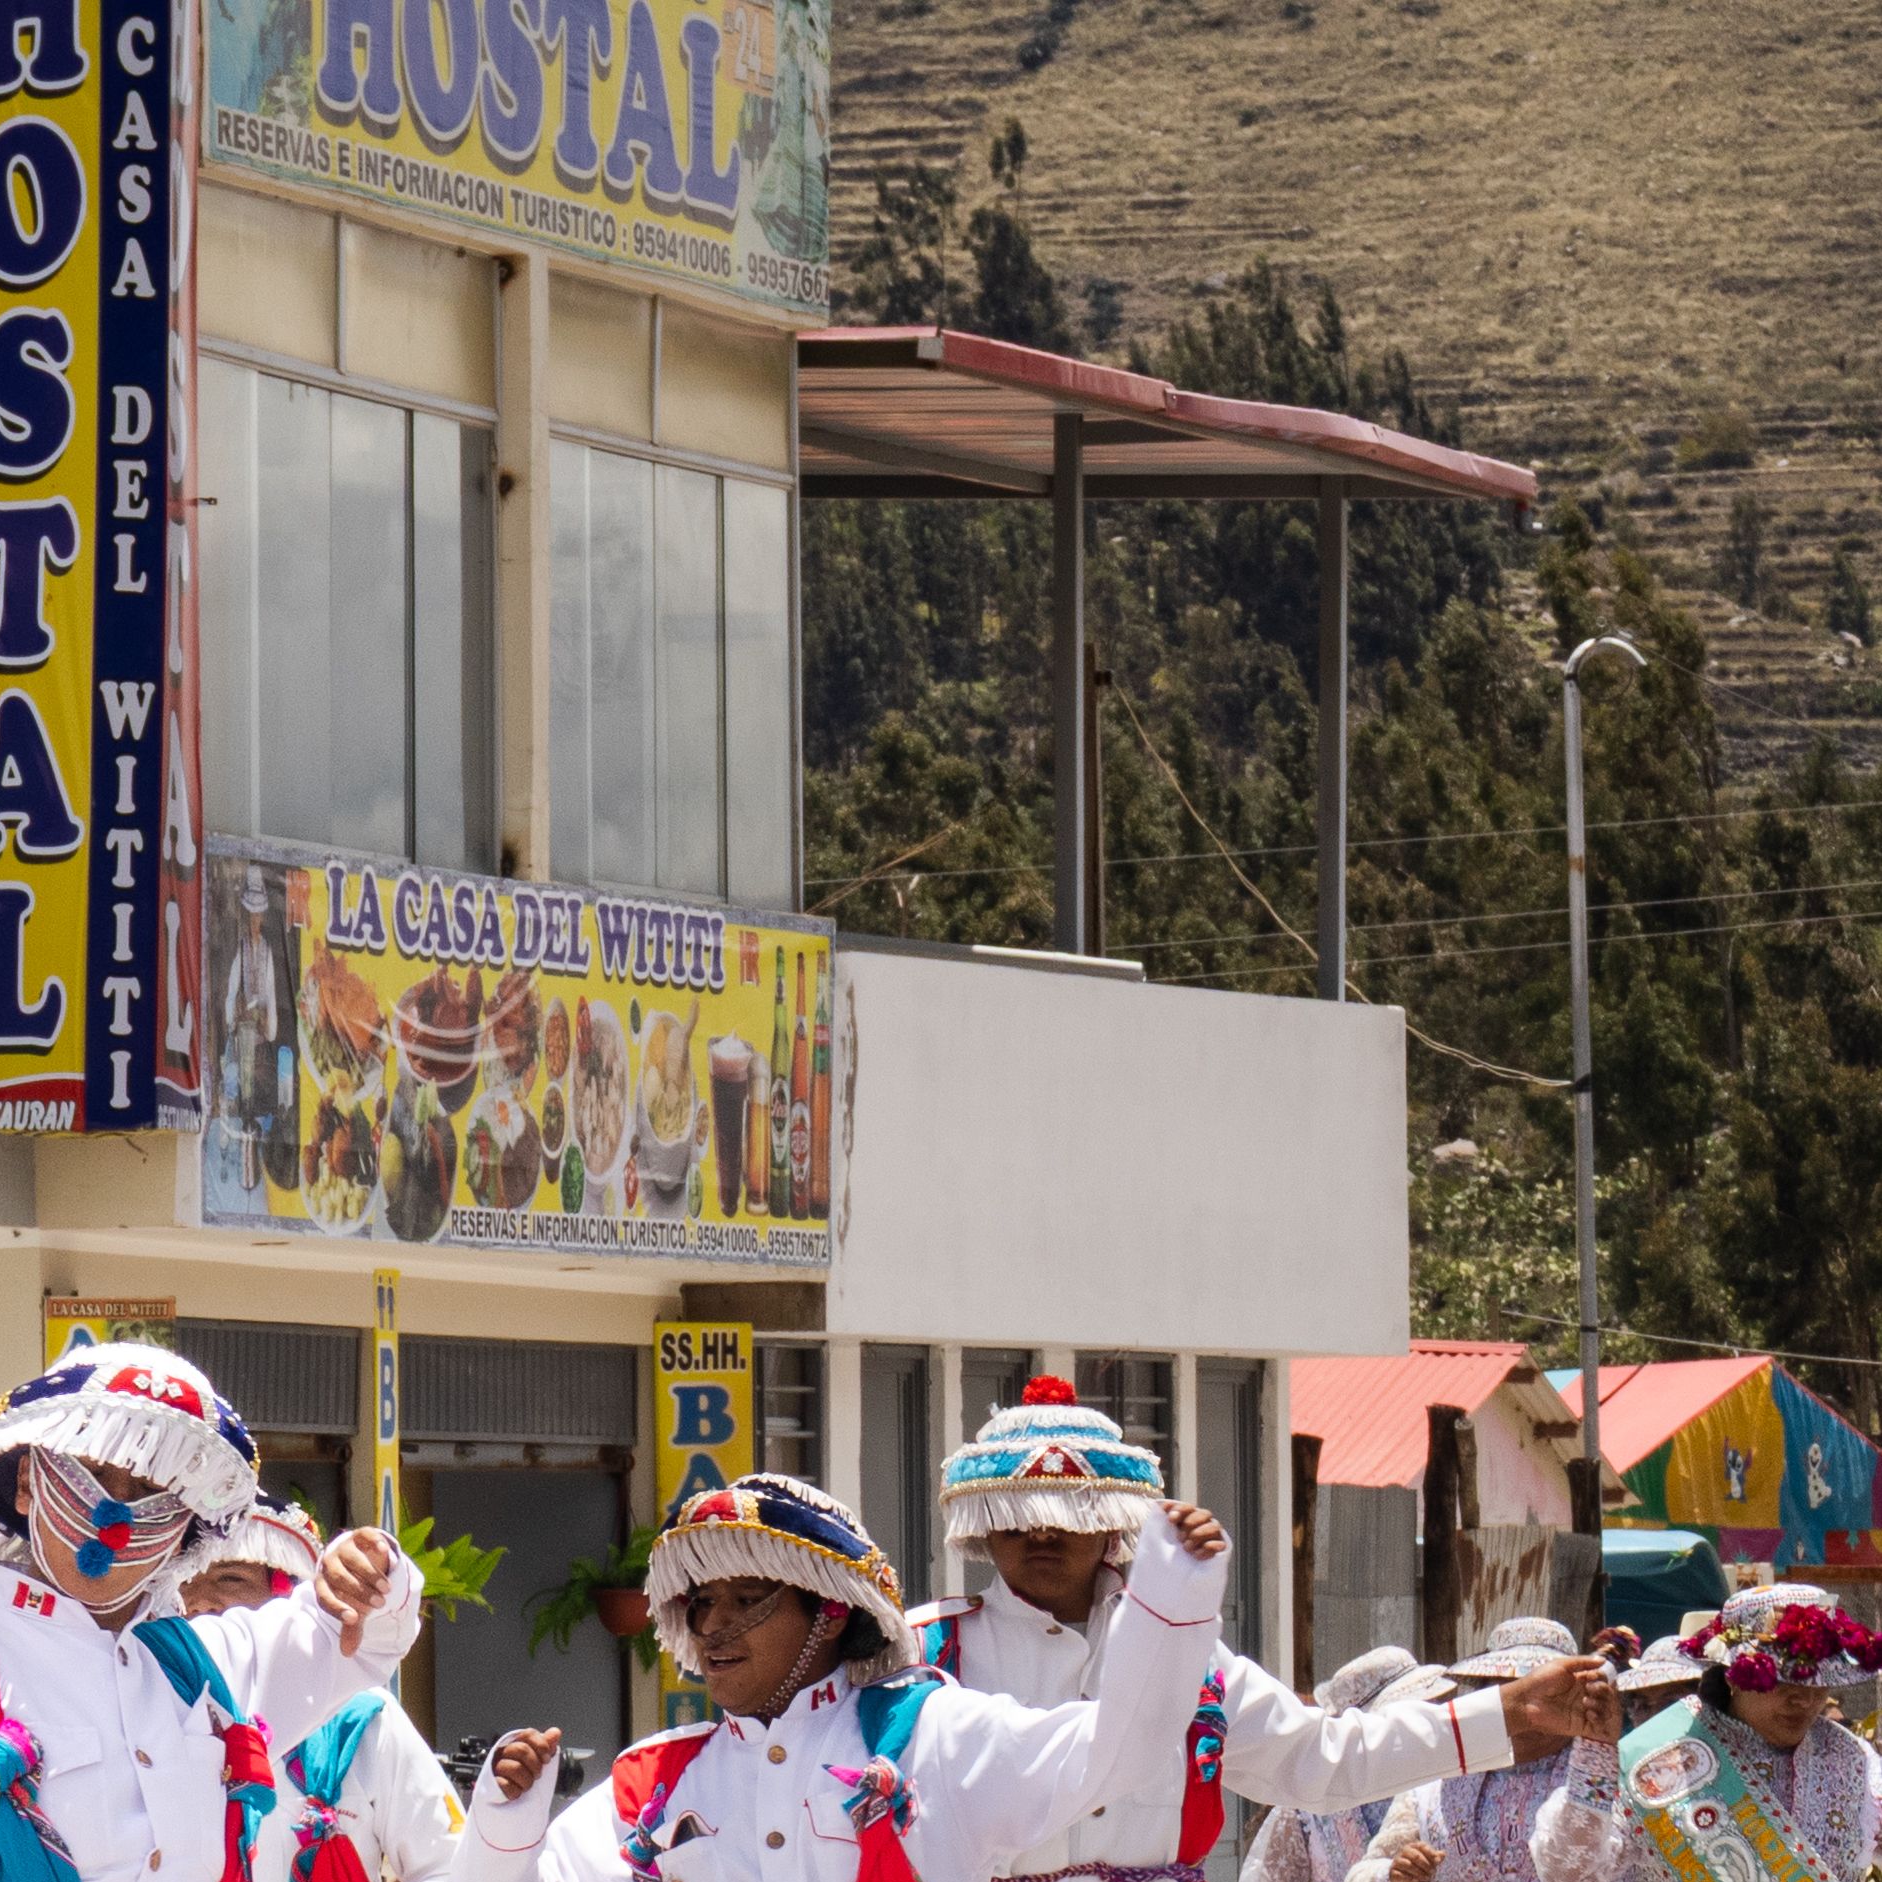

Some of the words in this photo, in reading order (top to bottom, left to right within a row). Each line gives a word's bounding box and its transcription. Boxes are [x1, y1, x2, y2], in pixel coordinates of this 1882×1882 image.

[112, 17, 157, 298] CASA
[217, 108, 330, 174] RESERVAS
[338, 142, 351, 178] E
[358, 147, 504, 220] INFORMACION
[510, 188, 616, 248] TURISTICO
[633, 222, 731, 278] 959410006
[111, 386, 153, 594] DEL
[99, 681, 156, 1109] WITITI
[326, 860, 387, 950] LA
[393, 869, 507, 967] CASA
[512, 886, 591, 974] DEL
[596, 896, 725, 990] WITITI
[451, 1209, 517, 1239] RESERVAS
[521, 1215, 527, 1240] E
[532, 1215, 618, 1246] INFORMACION
[623, 1220, 686, 1249] TURISTICO
[696, 1225, 758, 1253] 959410006
[768, 1231, 827, 1258] 959576672
[52, 1303, 67, 1315] LA
[71, 1303, 101, 1316] CASA
[105, 1303, 126, 1315] DEL
[129, 1303, 168, 1315] WITITI
[661, 1332, 746, 1371] SS.HH.
